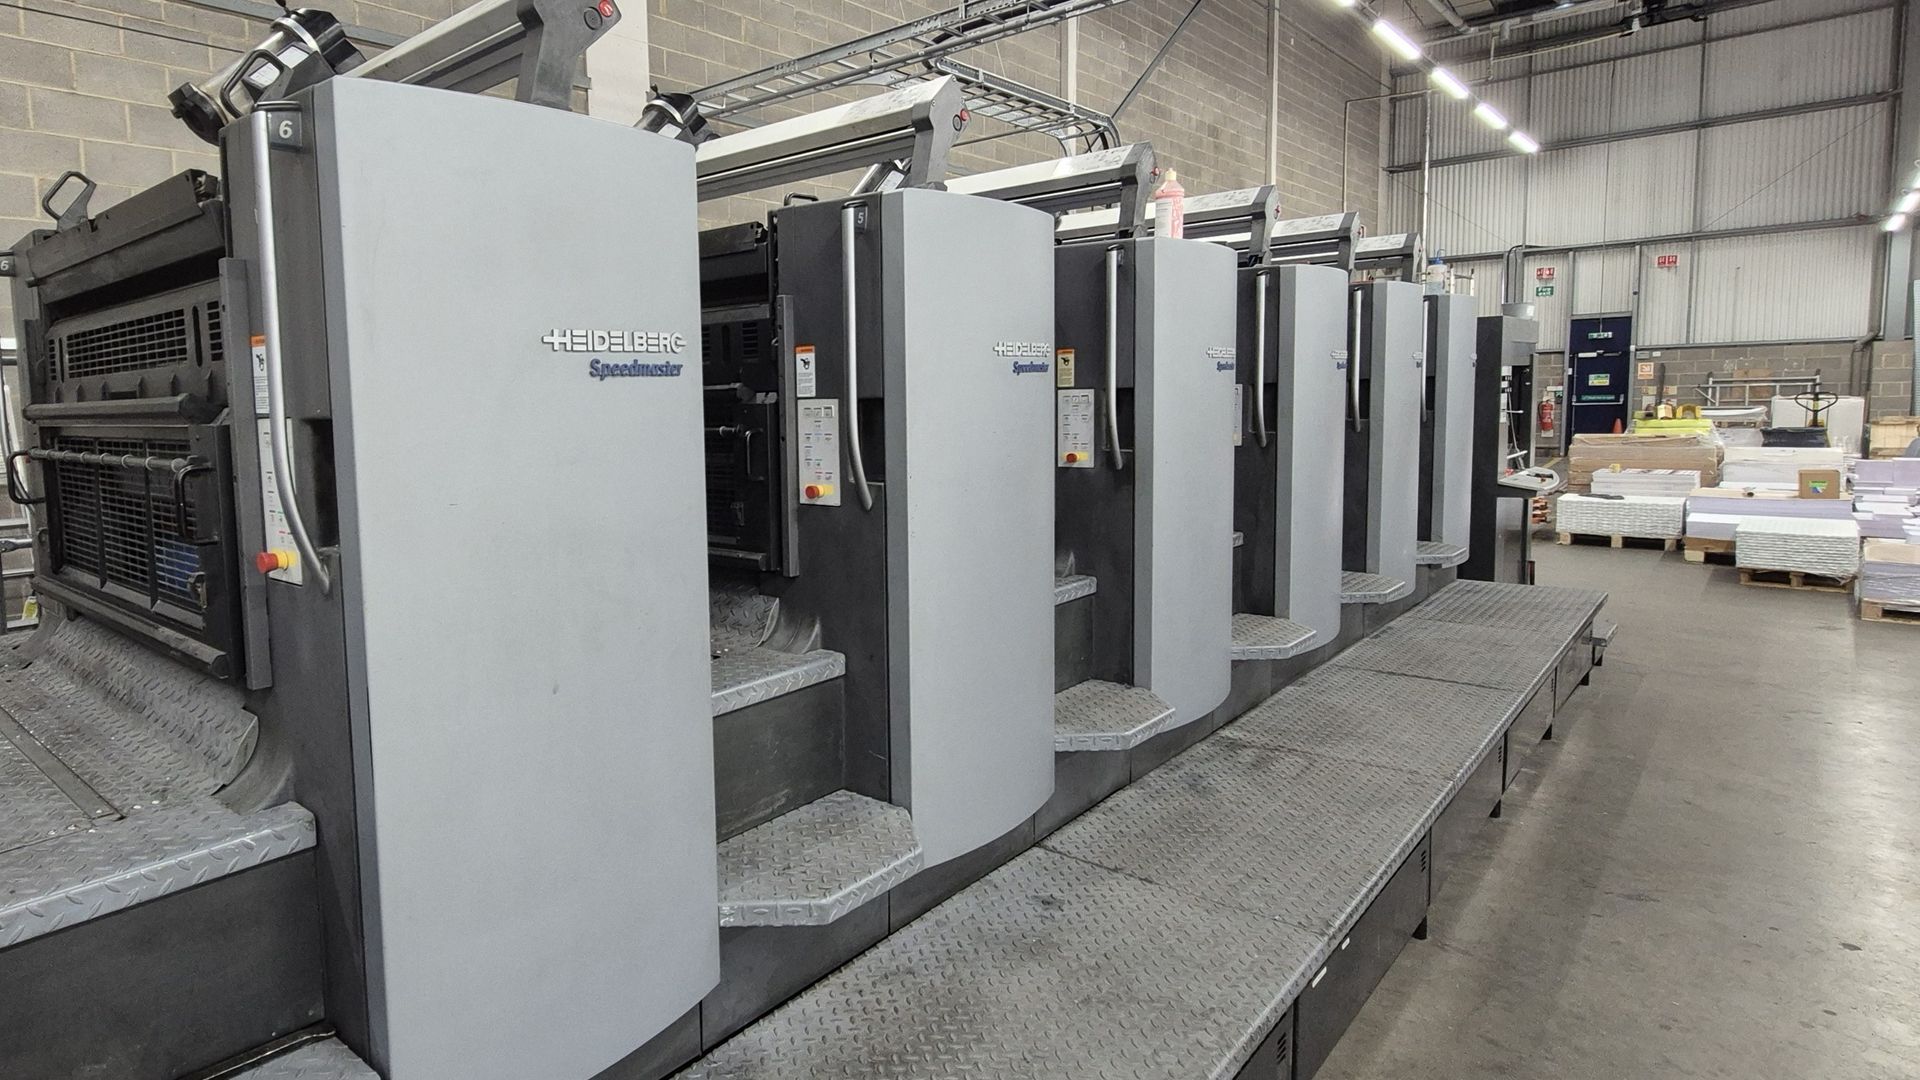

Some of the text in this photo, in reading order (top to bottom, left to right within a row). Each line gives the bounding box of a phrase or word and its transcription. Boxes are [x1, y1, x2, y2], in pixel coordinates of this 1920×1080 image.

[279, 120, 292, 138] 6
[857, 212, 864, 224] 5
[1, 260, 9, 271] 6
[542, 328, 687, 353] HEIDELBERG
[993, 341, 1051, 357] HEIDELBERG
[589, 358, 683, 381] Speedmaster
